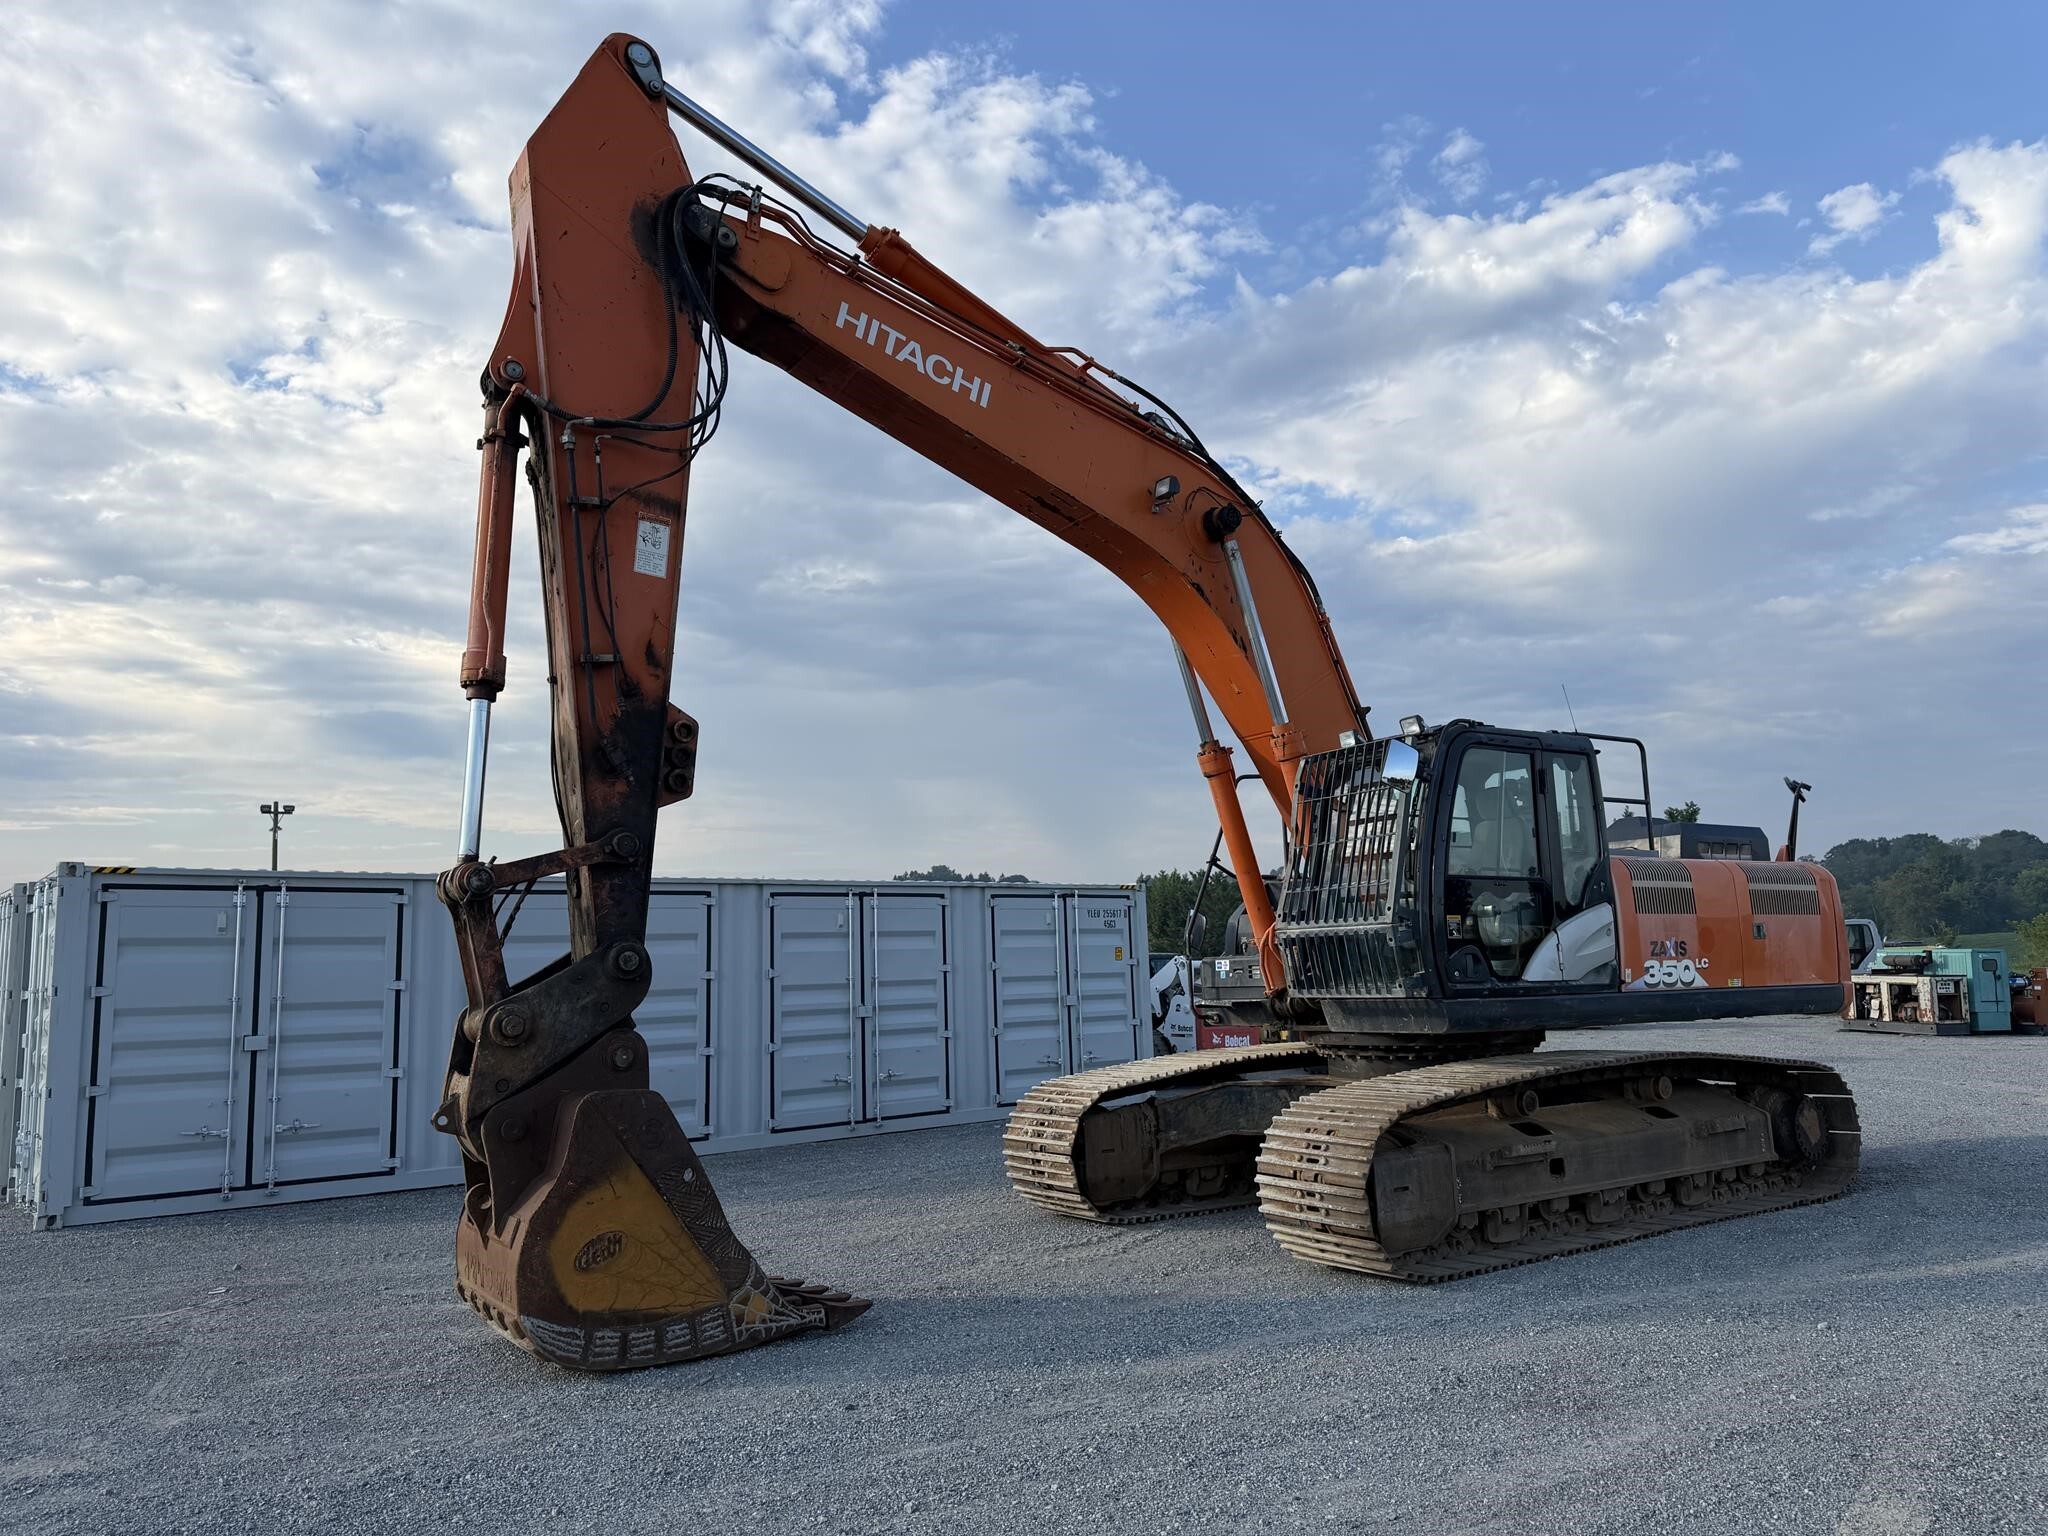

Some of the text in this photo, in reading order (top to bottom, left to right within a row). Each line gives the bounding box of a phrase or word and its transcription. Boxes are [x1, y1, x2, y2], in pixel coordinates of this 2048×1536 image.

[835, 301, 992, 408] HITACHI
[1650, 938, 1687, 957] ZAXIS
[1643, 959, 1696, 988] 350
[1695, 958, 1709, 969] LC
[1224, 1034, 1250, 1047] Bobcat
